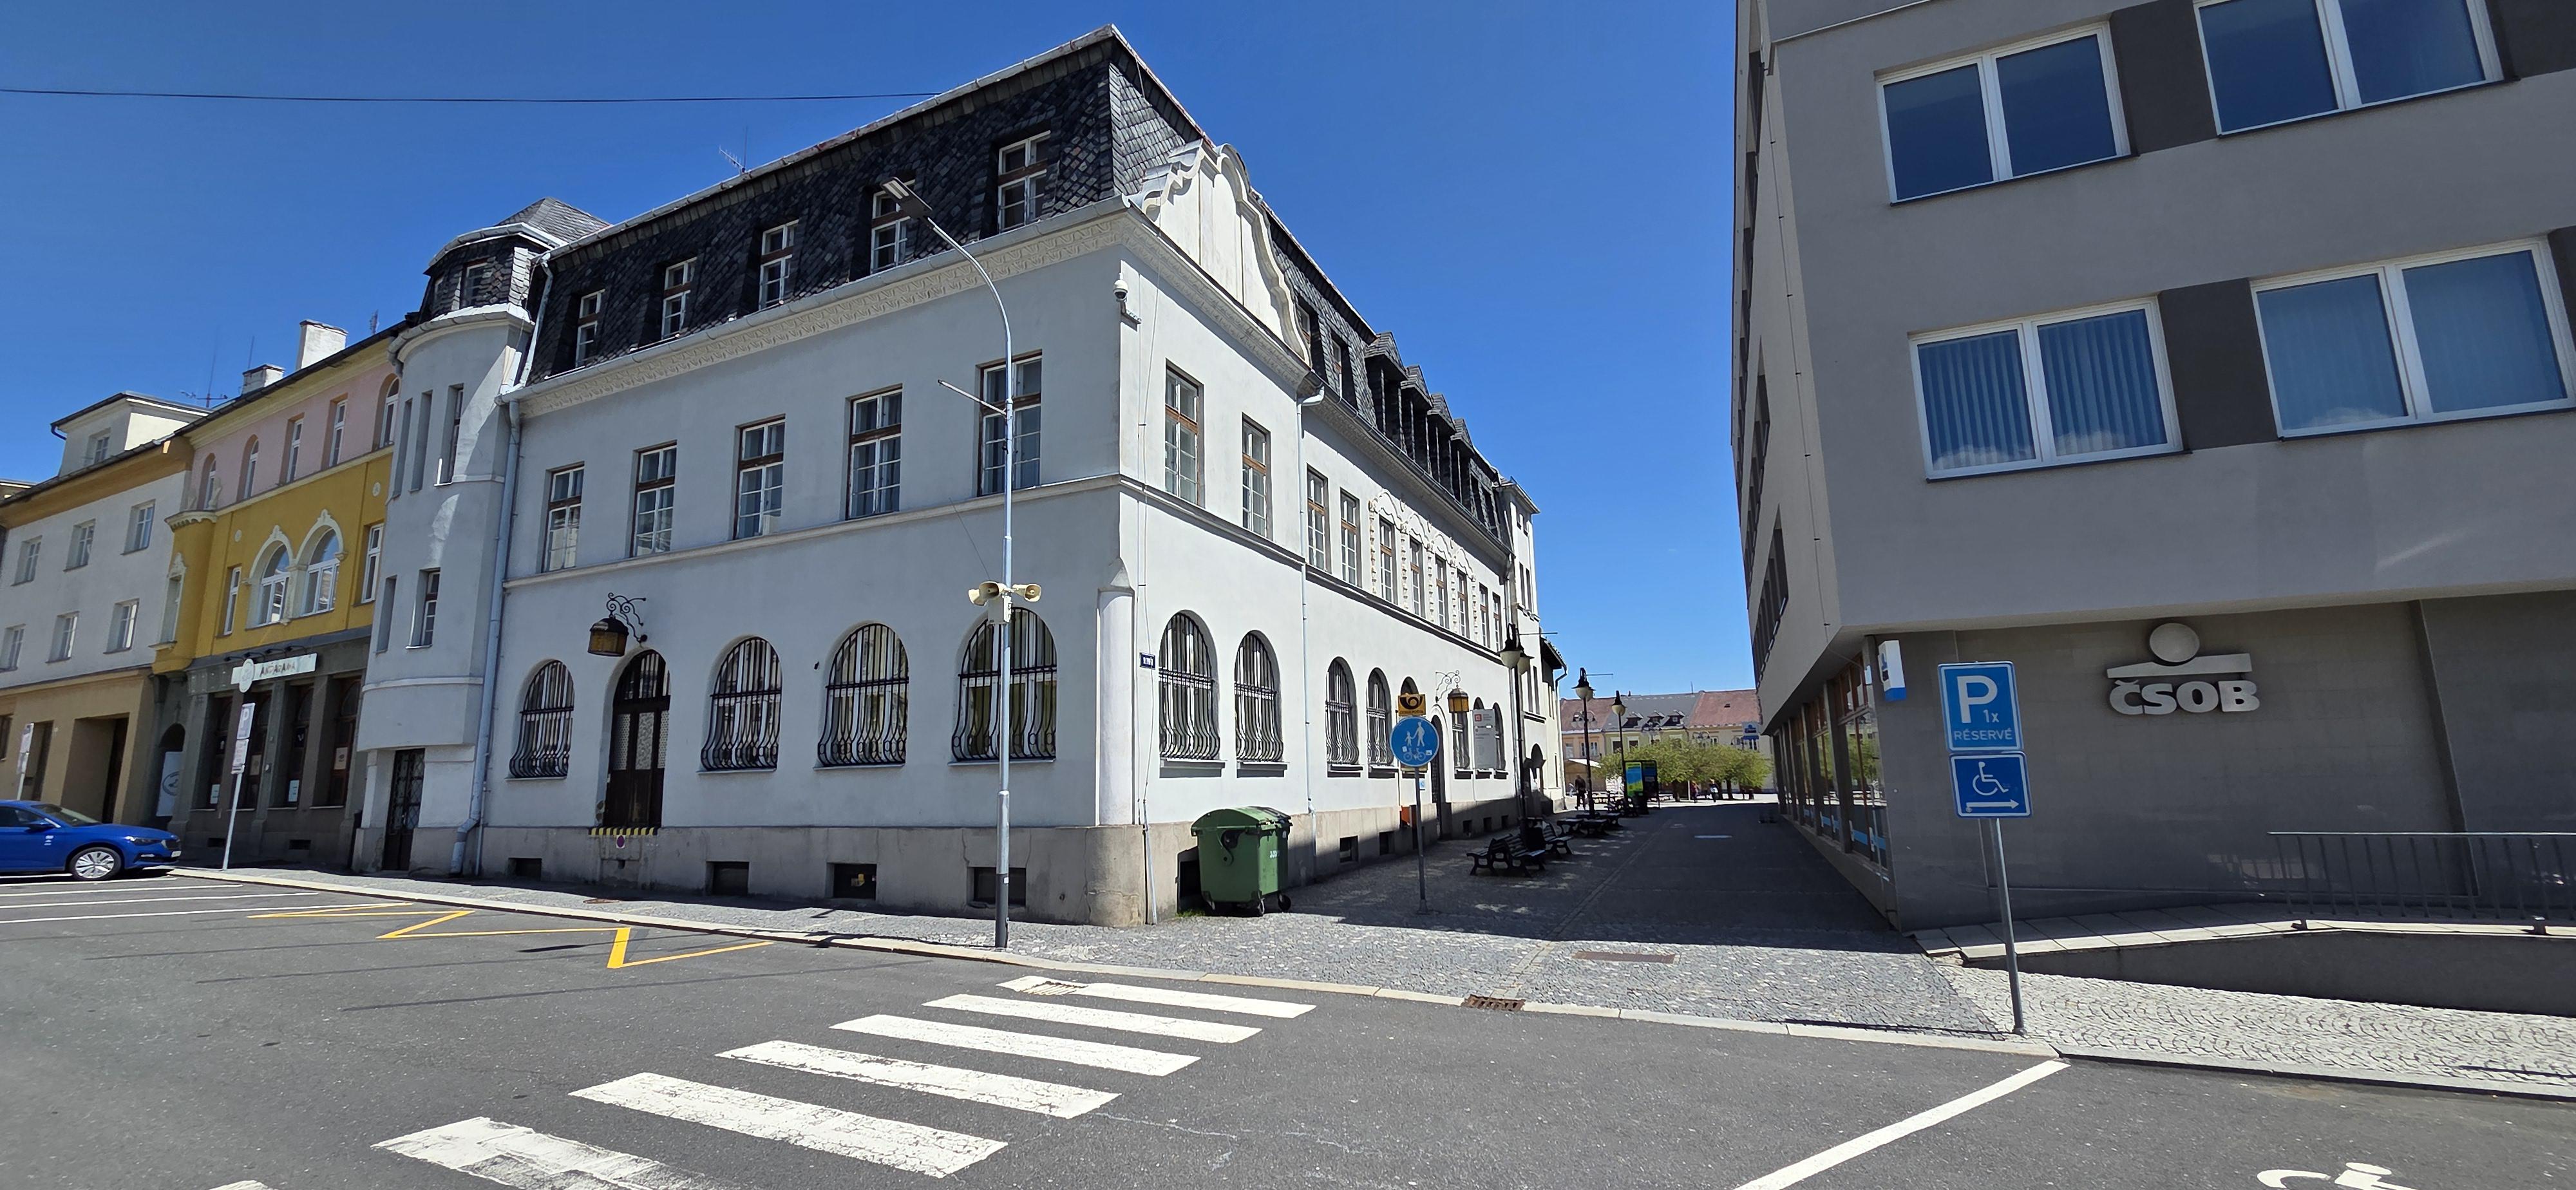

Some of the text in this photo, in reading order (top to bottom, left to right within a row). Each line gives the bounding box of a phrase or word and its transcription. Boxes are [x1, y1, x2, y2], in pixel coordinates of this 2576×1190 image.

[1956, 675, 1998, 724] P
[2109, 679, 2260, 715] ČSOB
[241, 709, 249, 728] P
[1983, 709, 2000, 723] 1x
[1954, 728, 2013, 741] RÉSERVÉ
